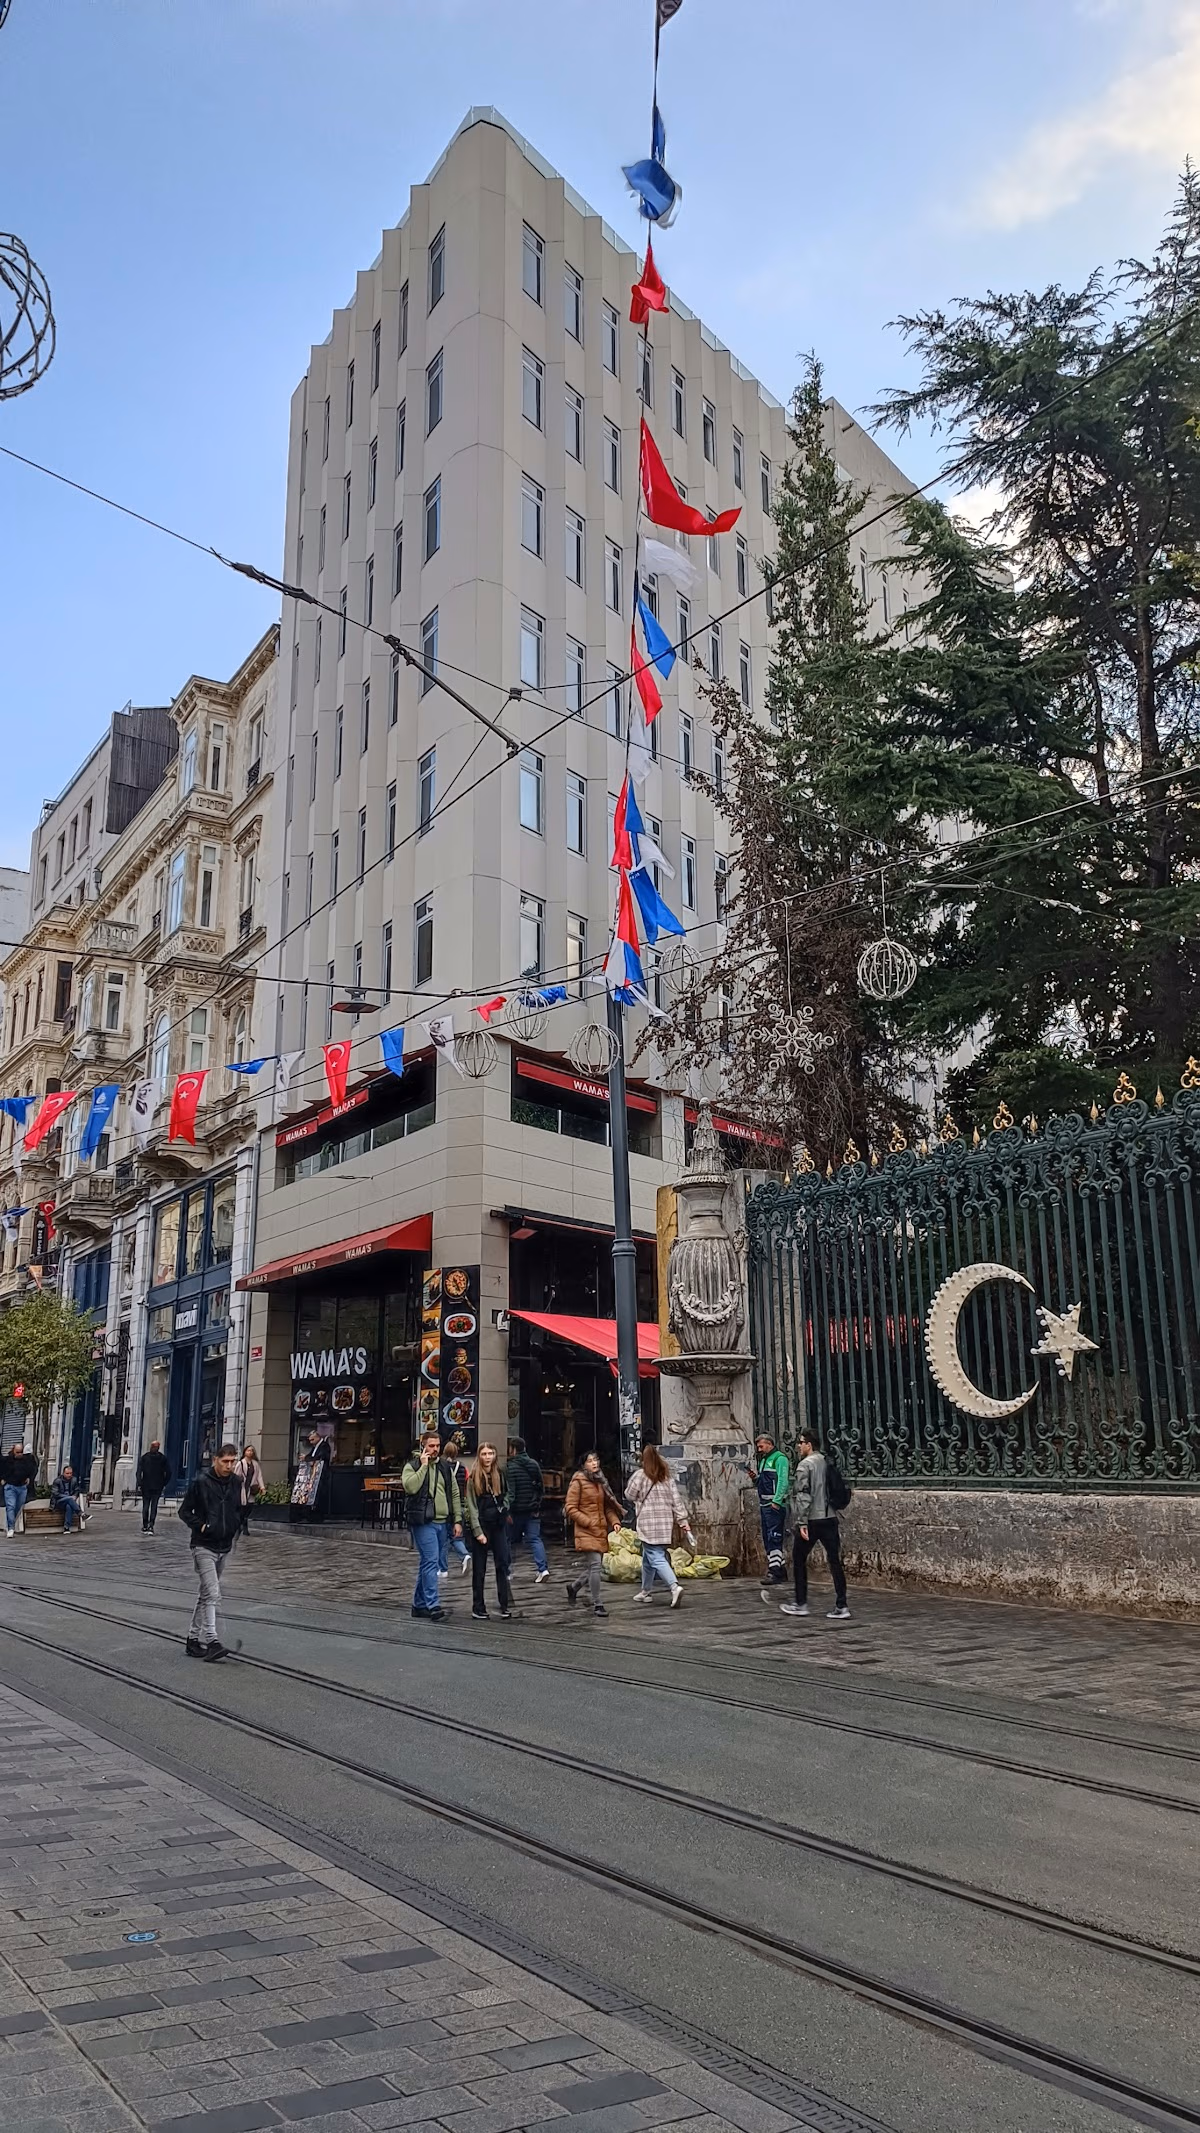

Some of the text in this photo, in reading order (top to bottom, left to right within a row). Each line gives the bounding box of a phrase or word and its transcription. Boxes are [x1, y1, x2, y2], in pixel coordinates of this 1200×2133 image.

[573, 1080, 610, 1100] WAMA'S
[285, 1126, 308, 1142] WAMA'S
[727, 1124, 757, 1140] WAMAS
[345, 1243, 372, 1260] WAMA'S
[292, 1260, 317, 1275] WAMA'S
[246, 1273, 268, 1287] WAMA'S
[175, 1303, 198, 1331] mavi
[290, 1346, 368, 1380] WAMA'S
